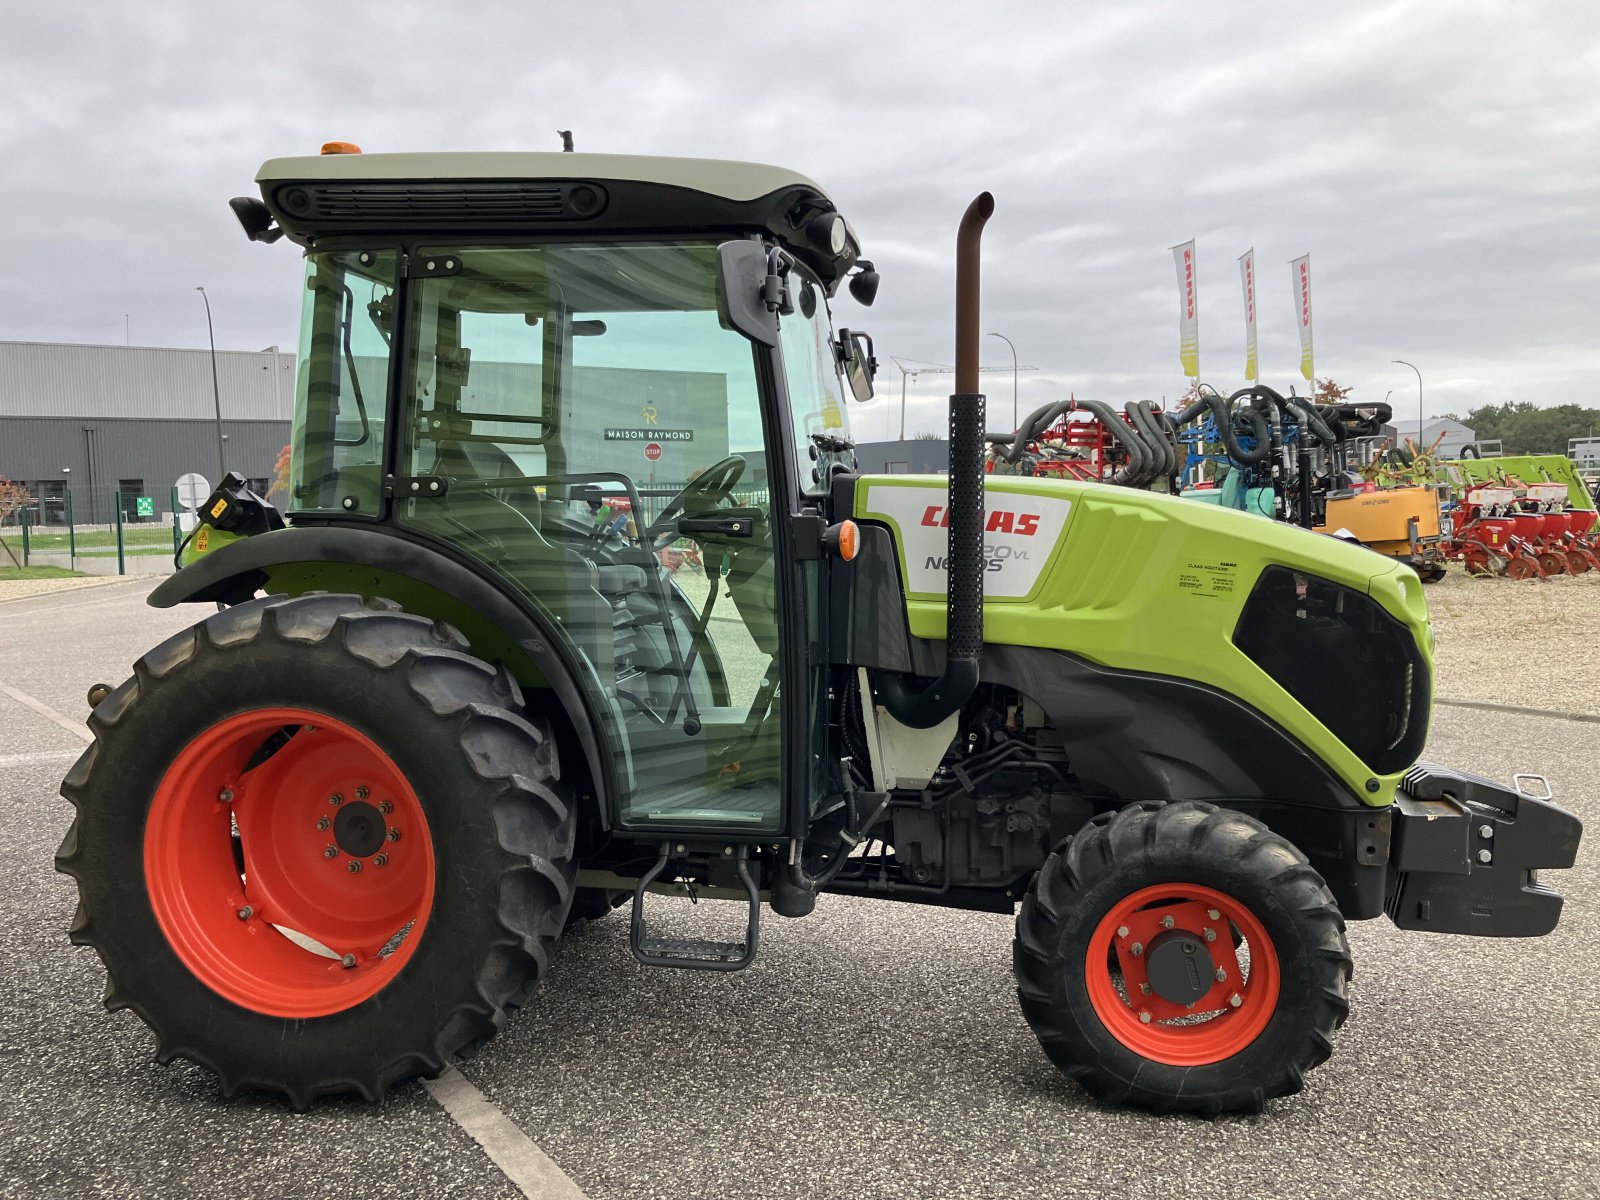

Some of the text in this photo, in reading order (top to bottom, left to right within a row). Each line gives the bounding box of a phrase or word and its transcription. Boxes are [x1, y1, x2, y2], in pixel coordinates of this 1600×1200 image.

[608, 430, 691, 440] MAISON RAYMOND
[646, 448, 661, 456] STOP
